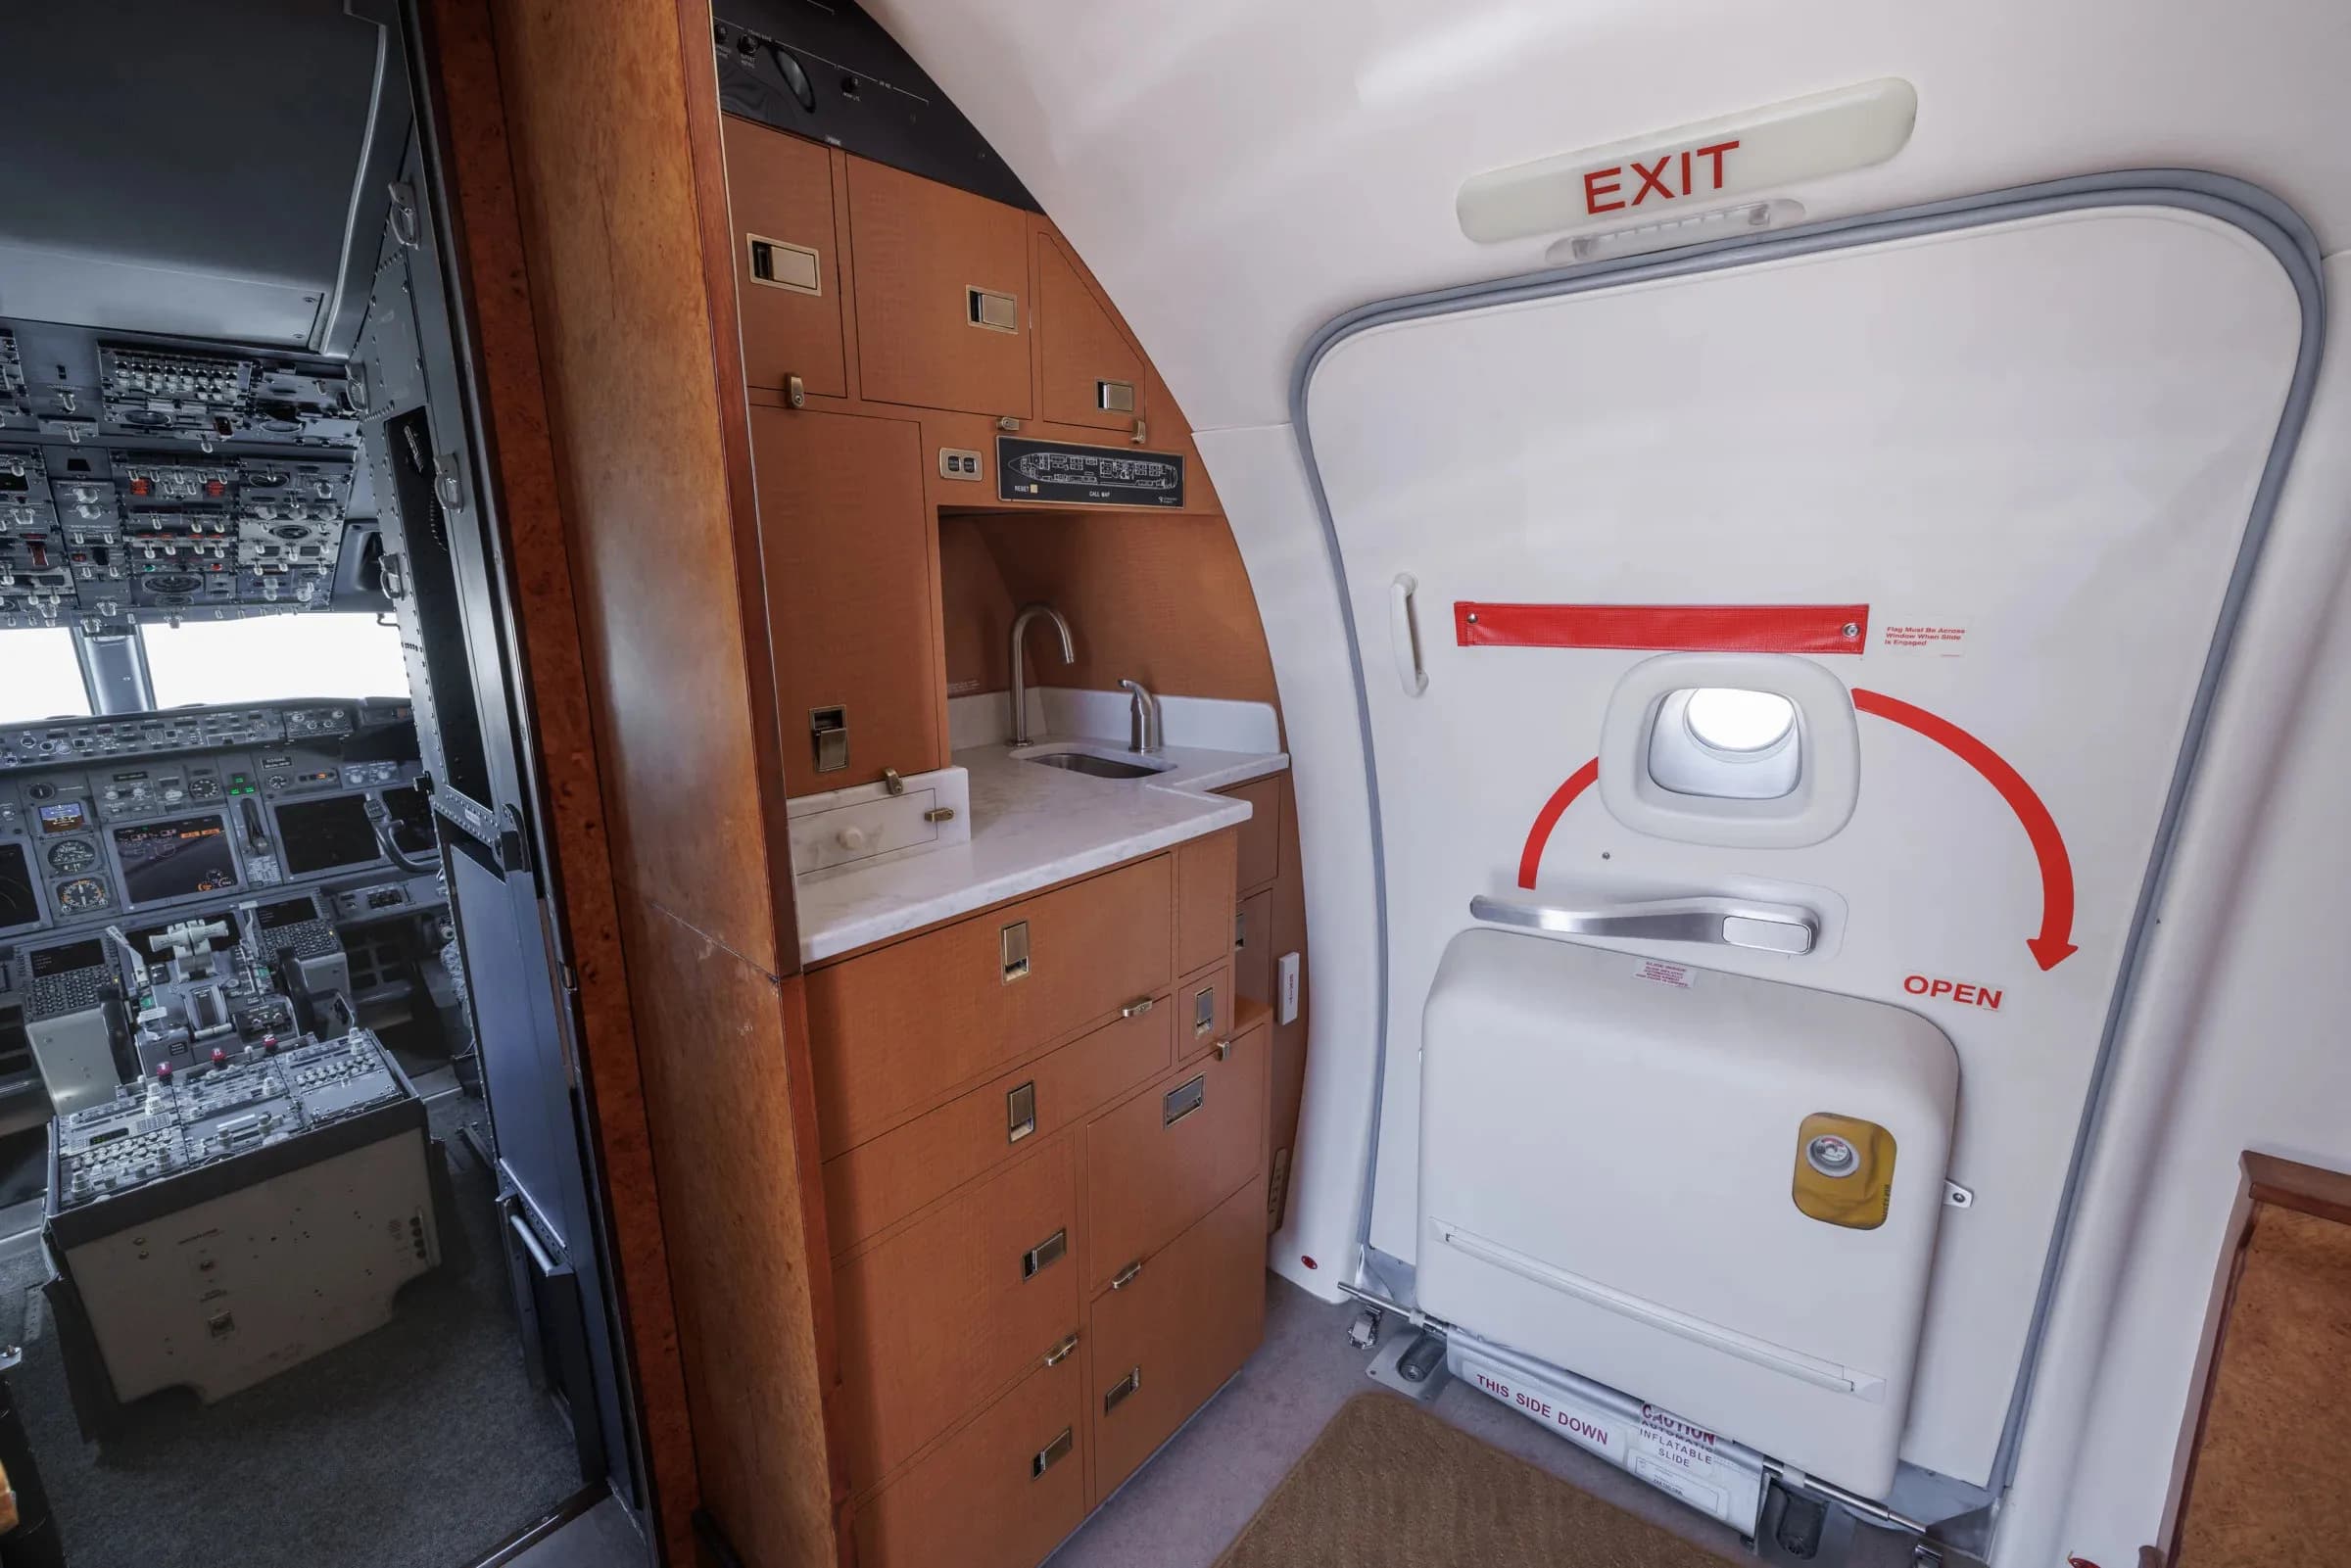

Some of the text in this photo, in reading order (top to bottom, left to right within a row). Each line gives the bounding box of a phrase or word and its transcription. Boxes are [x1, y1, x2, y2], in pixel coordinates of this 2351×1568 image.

[1584, 140, 1740, 214] EXIT
[1903, 974, 2003, 1009] OPEN
[1476, 1373, 1608, 1446] THIS SIDE DOWN
[1642, 1403, 1716, 1446] CAUTION
[1640, 1428, 1713, 1465] INFLATABLE
[1658, 1448, 1690, 1467] SLIDE
